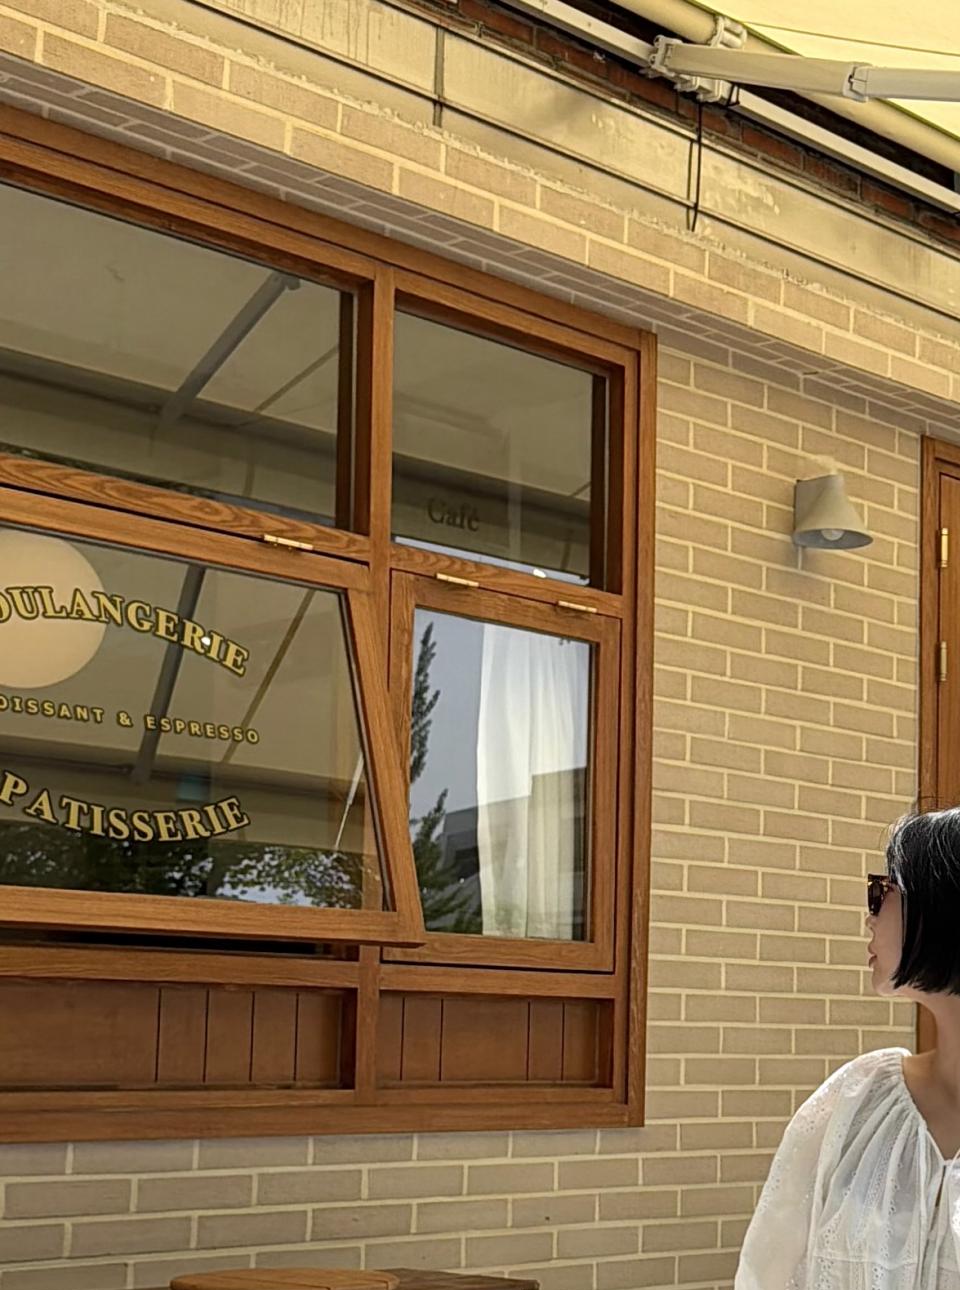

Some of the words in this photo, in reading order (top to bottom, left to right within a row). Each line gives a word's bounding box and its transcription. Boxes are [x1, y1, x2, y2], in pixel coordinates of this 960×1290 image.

[117, 711, 133, 727] &
[144, 715, 260, 744] ESPRESSO
[0, 770, 250, 842] PATISSERIE
